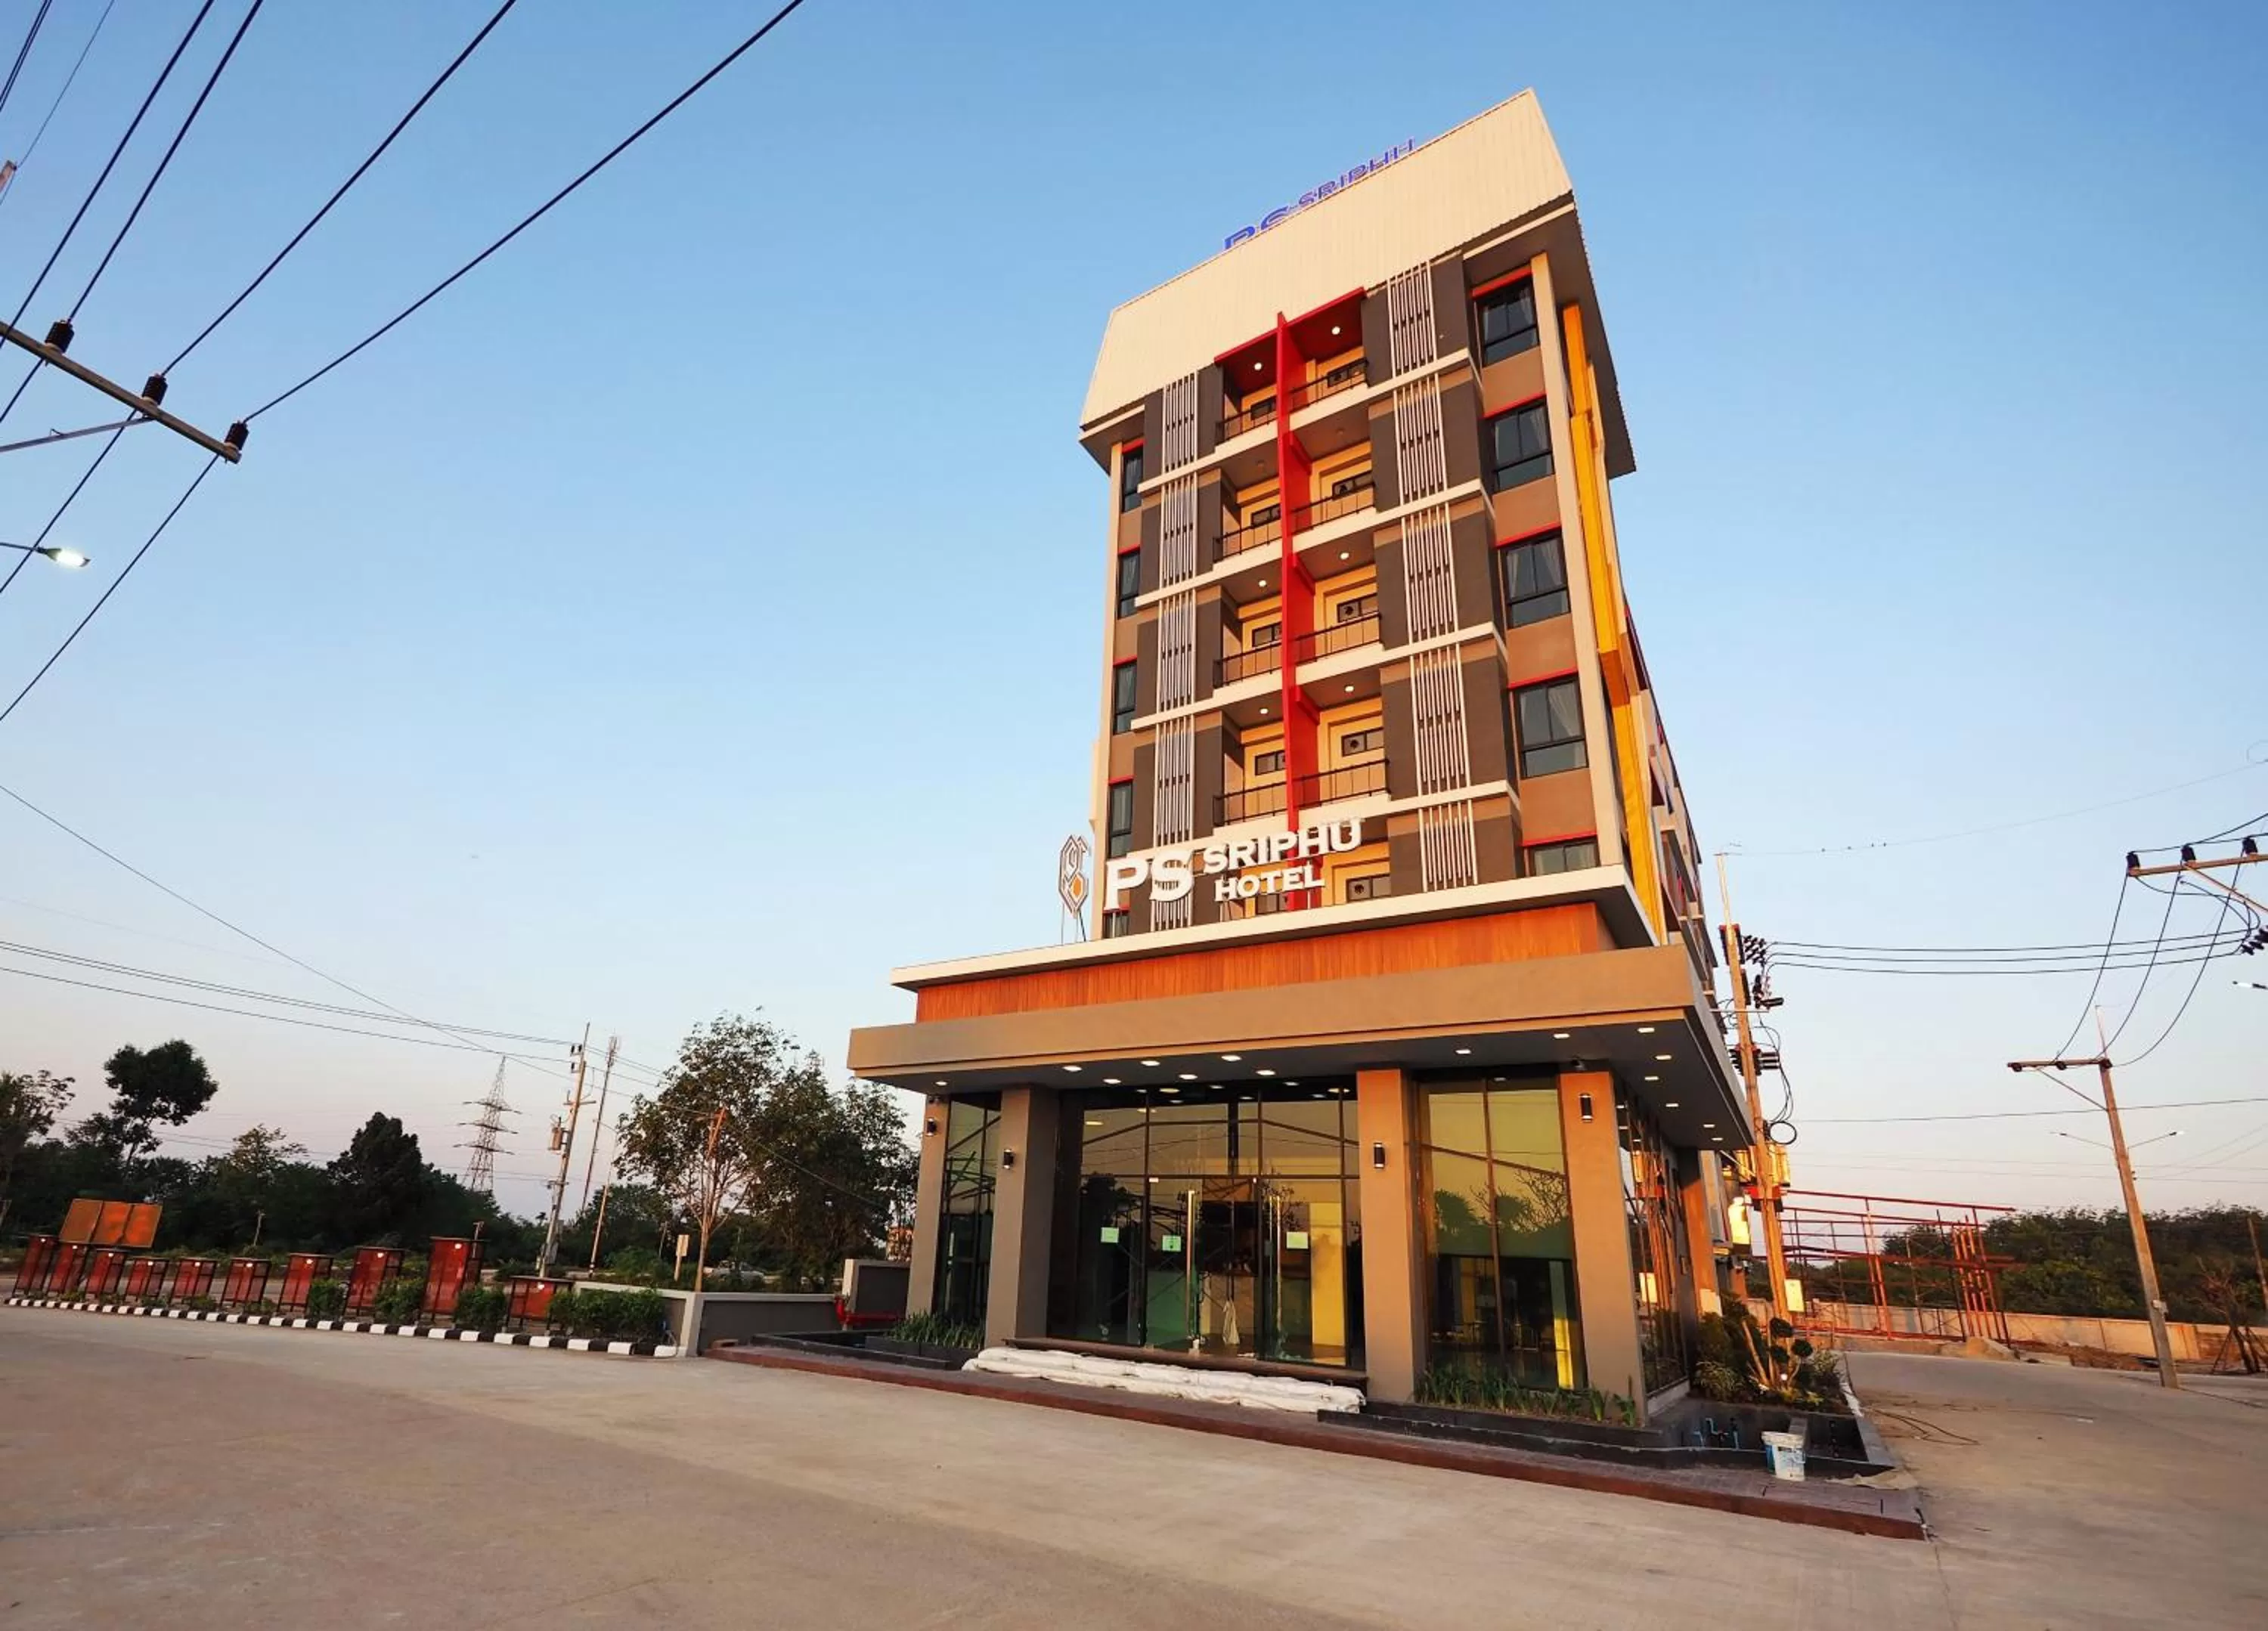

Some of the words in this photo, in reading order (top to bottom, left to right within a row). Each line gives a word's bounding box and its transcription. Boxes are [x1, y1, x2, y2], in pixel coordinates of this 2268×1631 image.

[1104, 848, 1194, 911] PS
[1203, 816, 1363, 874] SRIPHU
[1214, 862, 1325, 902] HOTEL
